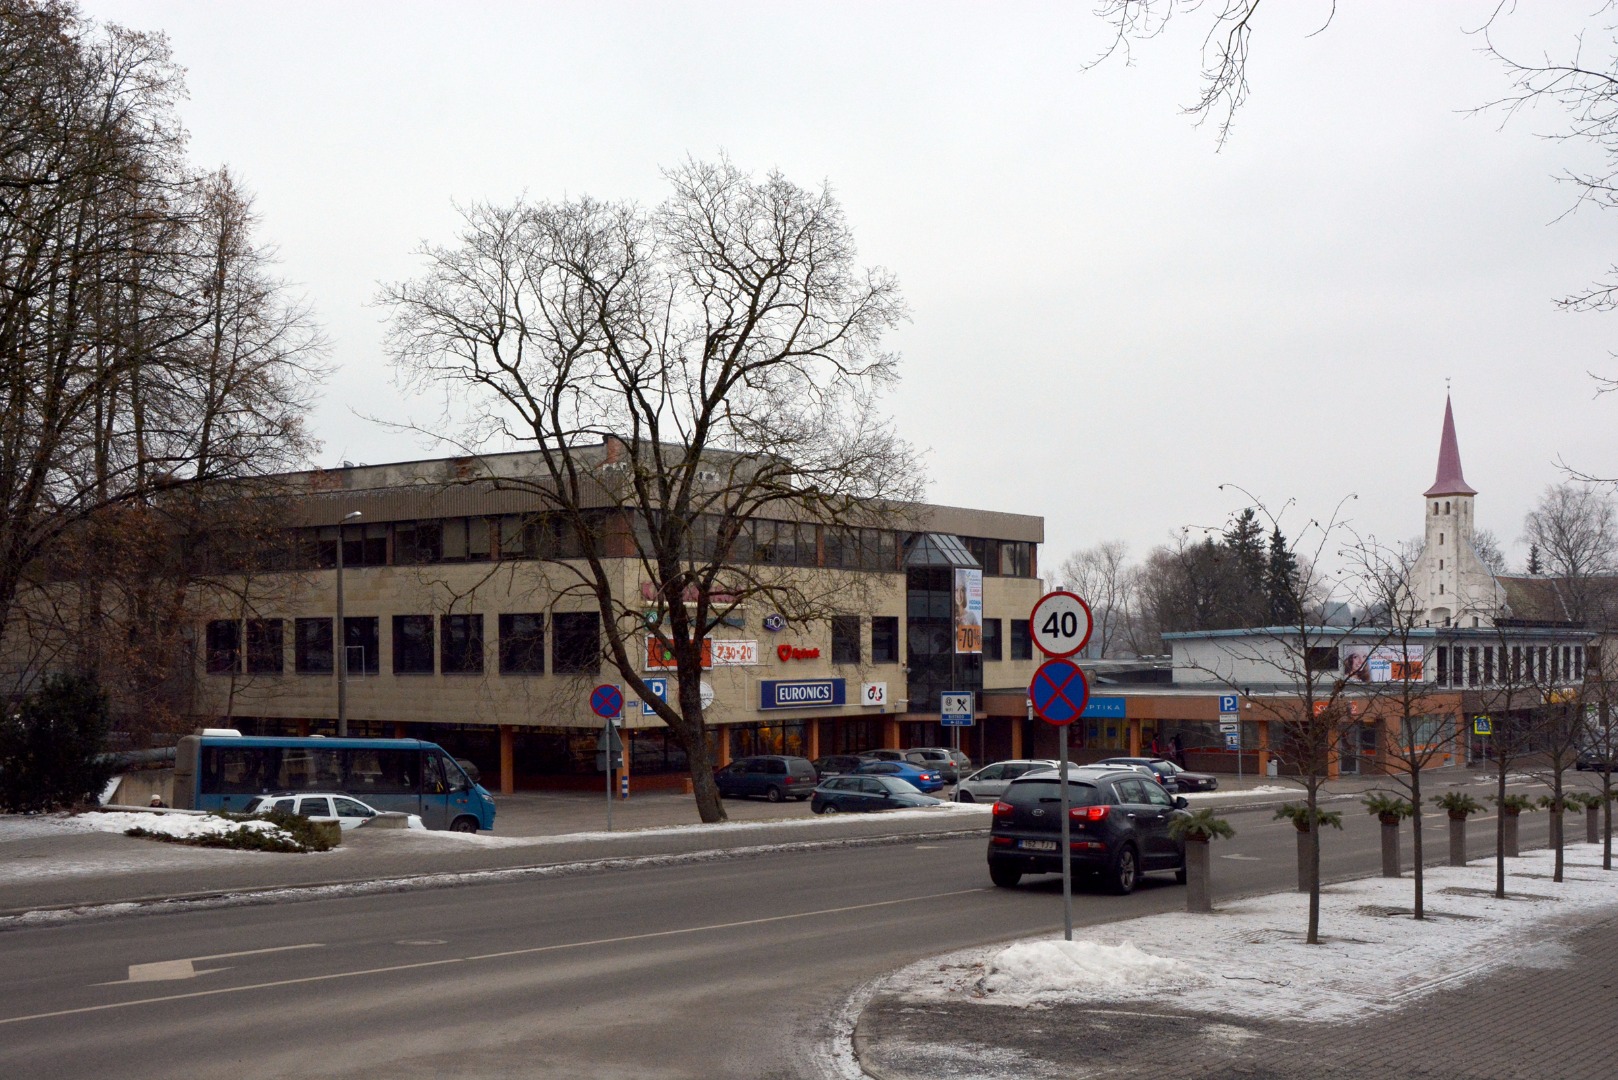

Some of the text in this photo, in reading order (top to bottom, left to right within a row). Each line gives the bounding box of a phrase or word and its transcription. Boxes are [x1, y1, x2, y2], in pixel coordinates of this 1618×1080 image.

[1042, 611, 1077, 638] 40
[959, 628, 980, 648] -70%
[779, 686, 829, 701] EURONICS
[868, 686, 883, 701] G4S
[1223, 697, 1234, 711] P
